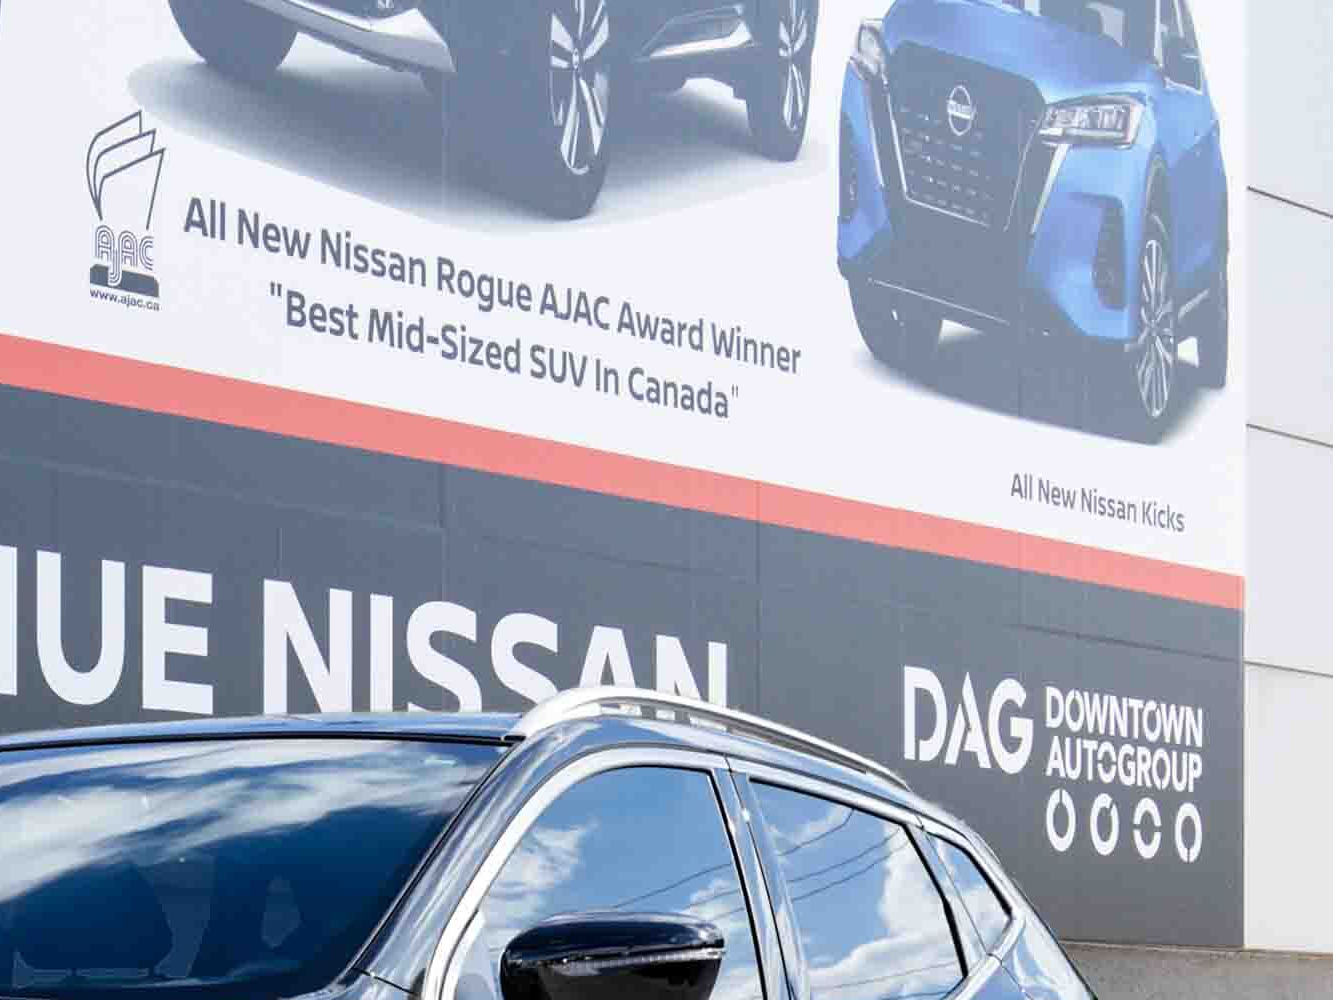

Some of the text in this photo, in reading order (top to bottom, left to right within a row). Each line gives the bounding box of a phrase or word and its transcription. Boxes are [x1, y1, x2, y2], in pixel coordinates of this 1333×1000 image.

[183, 196, 802, 374] All New Nissan Rogue AJAC Award Winner
[269, 281, 740, 419] "Best Mid-Sized SUV In Canada"
[1010, 473, 1185, 533] All New Nissan Kicks
[903, 665, 1034, 775] DAG
[1045, 685, 1203, 748] DOWNTOWN
[1045, 735, 1203, 793] AUTOGROUP
